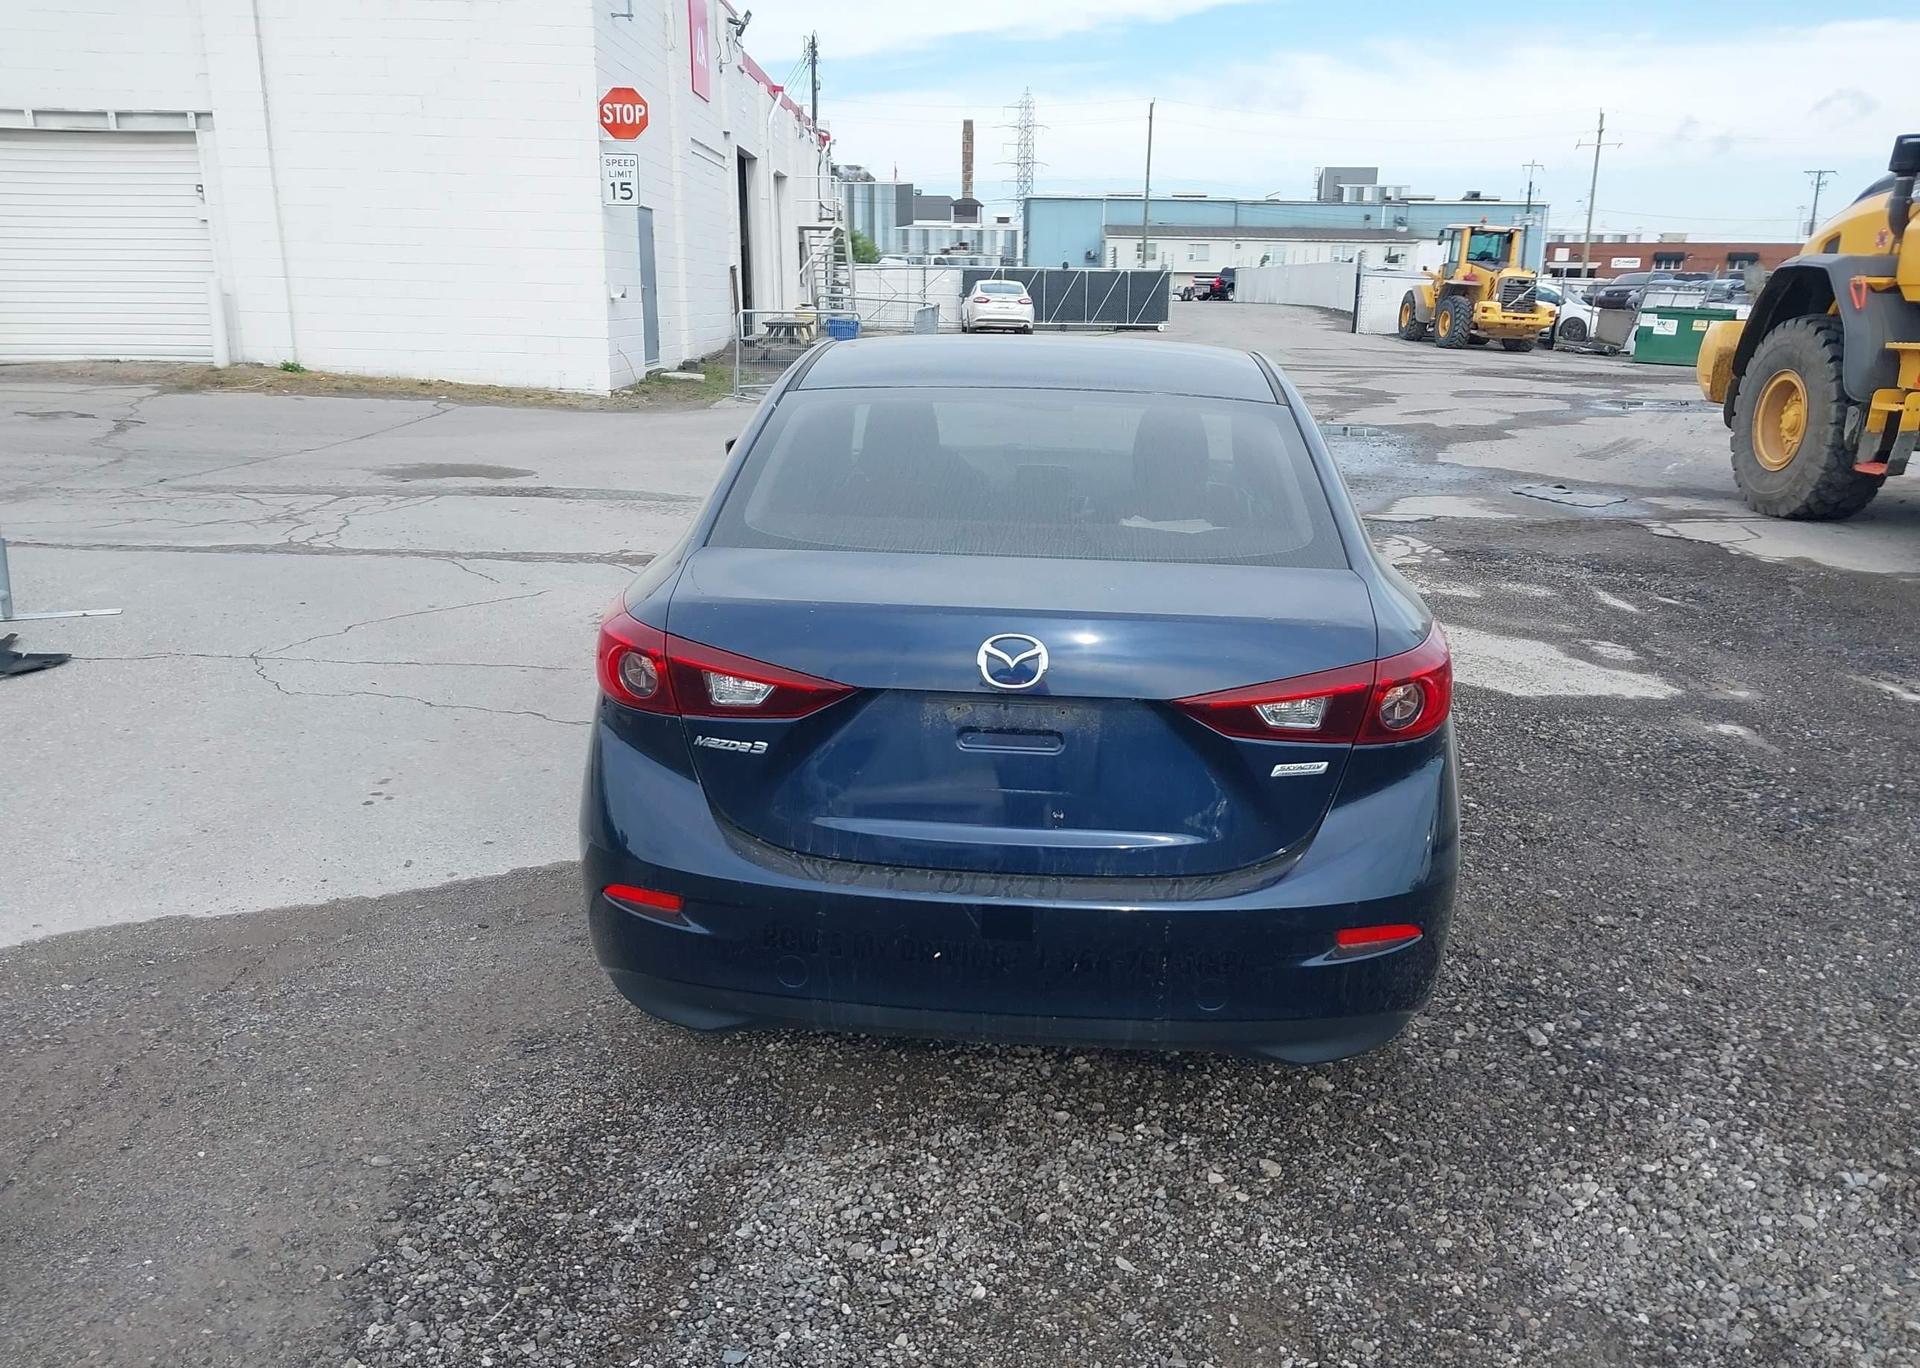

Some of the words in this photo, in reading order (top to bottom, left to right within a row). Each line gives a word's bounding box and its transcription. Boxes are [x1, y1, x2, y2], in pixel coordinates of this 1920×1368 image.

[602, 103, 646, 125] STOP
[605, 158, 636, 167] SPEED
[608, 170, 633, 178] LIMIT
[609, 182, 633, 200] 15
[1279, 763, 1325, 772] SKYACTIV
